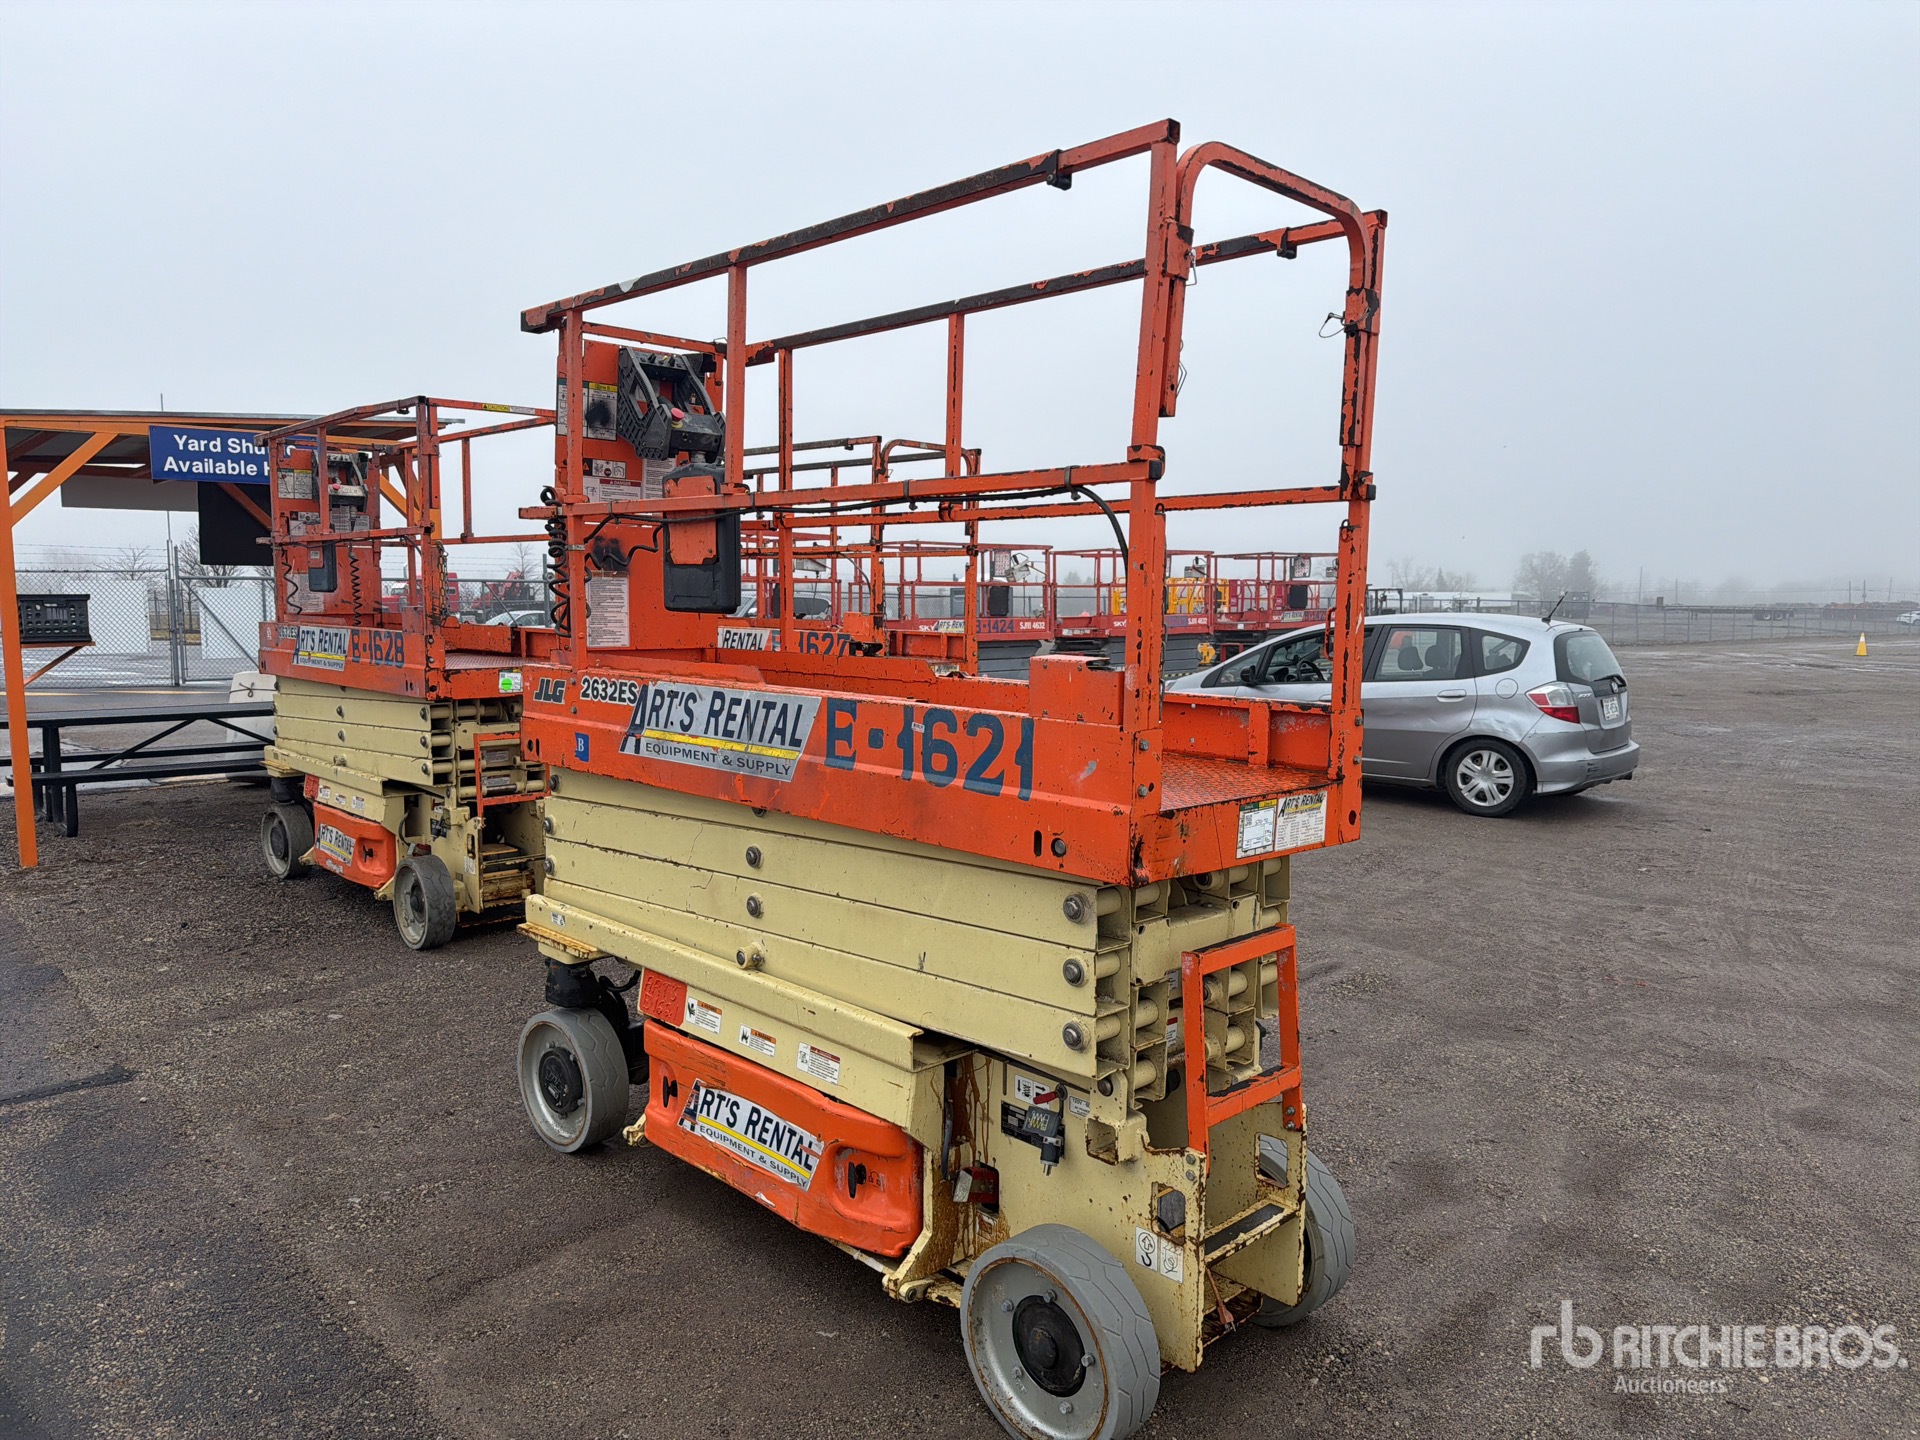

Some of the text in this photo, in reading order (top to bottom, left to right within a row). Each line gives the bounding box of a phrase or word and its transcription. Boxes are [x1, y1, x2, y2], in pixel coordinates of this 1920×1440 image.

[173, 434, 222, 453] Yard
[163, 456, 258, 476] Available
[919, 622, 937, 631] SKY
[1114, 619, 1127, 627] SKY
[292, 626, 316, 664] ART'S
[318, 629, 347, 655] RENTAL
[723, 629, 764, 651] RENTAL
[533, 677, 566, 704] JLG
[580, 675, 639, 706] 2632ES
[619, 684, 803, 755] ART'S RENTAL
[646, 742, 792, 776] EQUIPMENT & SUPPLY
[744, 1105, 814, 1172] RENTAL
[700, 1125, 807, 1188] EQUIPMENT & SUPPLY
